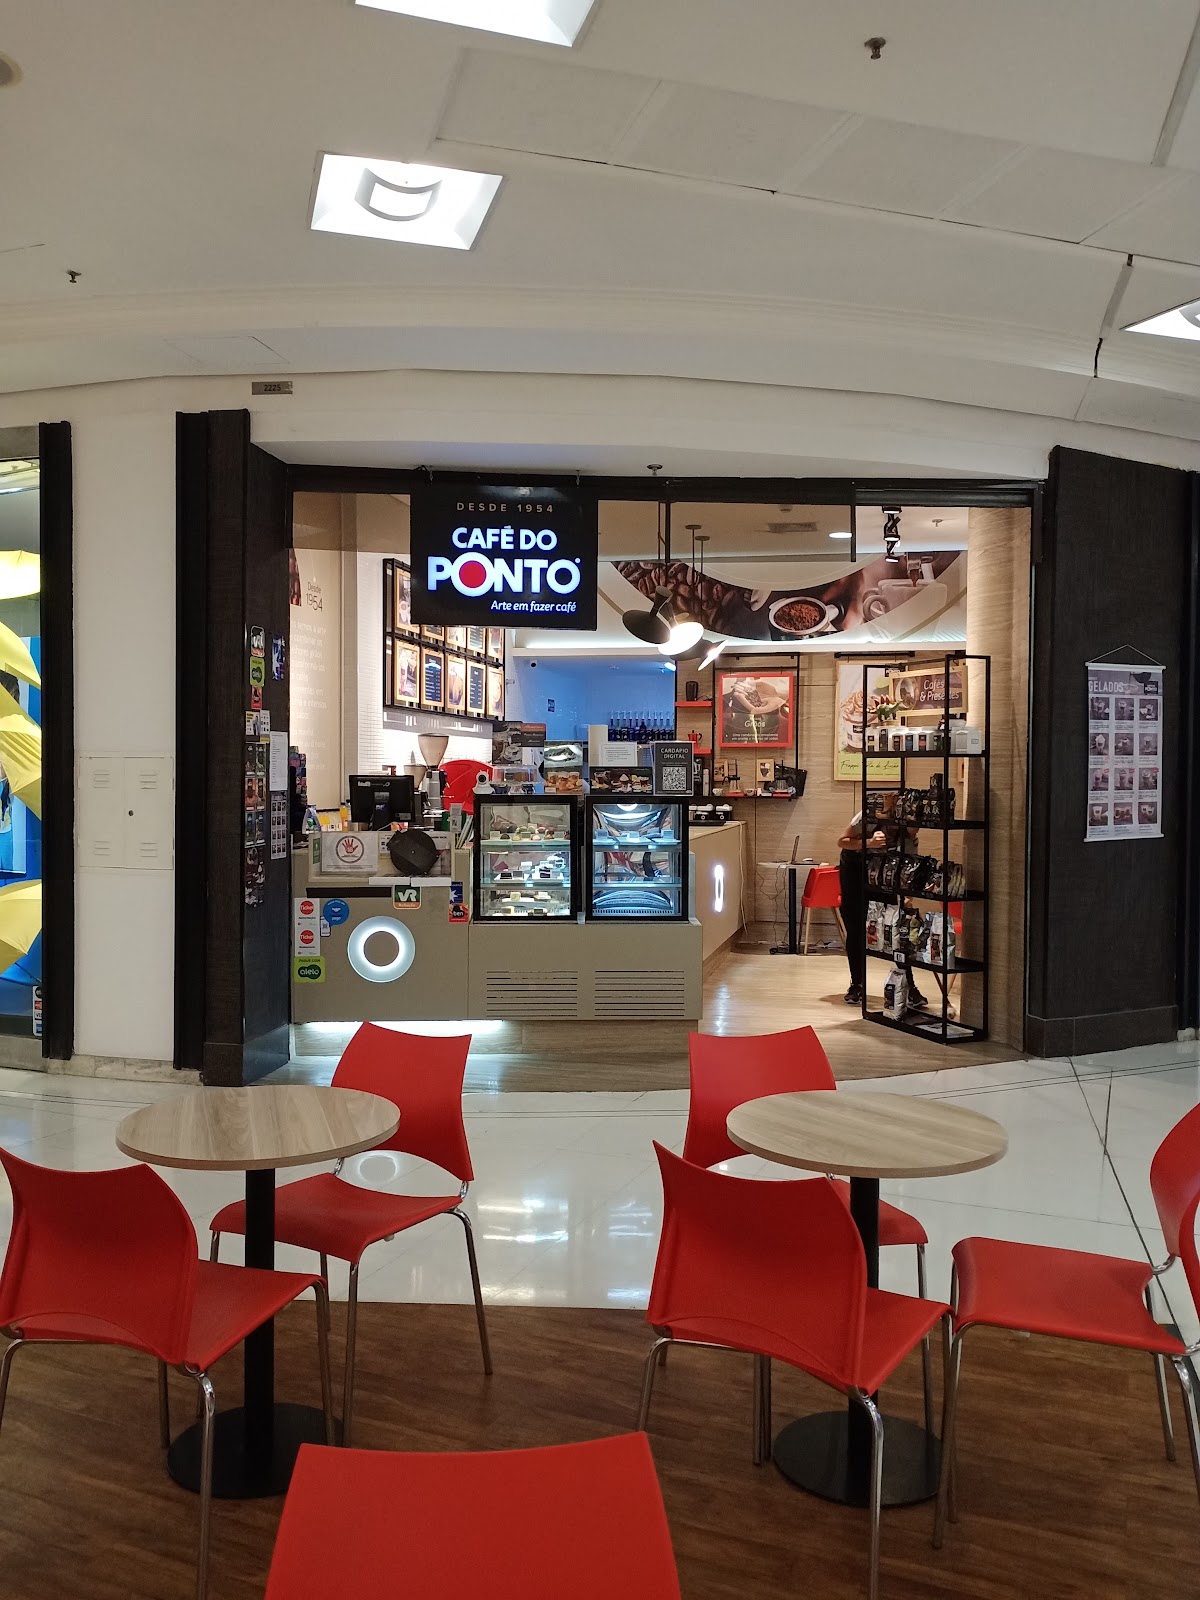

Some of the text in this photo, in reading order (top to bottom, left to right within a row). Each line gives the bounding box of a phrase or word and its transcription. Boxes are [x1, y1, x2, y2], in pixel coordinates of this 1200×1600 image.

[263, 384, 282, 392] 2225
[456, 502, 554, 513] DESDE 1954
[451, 525, 558, 551] CAFÉ DO
[427, 552, 581, 597] PONTO
[307, 581, 322, 594] Desde
[305, 592, 323, 612] 1954
[490, 600, 577, 613] Arte em fazer café
[923, 679, 946, 692] Cafés
[1088, 680, 1124, 693] GELADOS
[920, 690, 960, 701] & Presetes
[397, 889, 417, 902] VR
